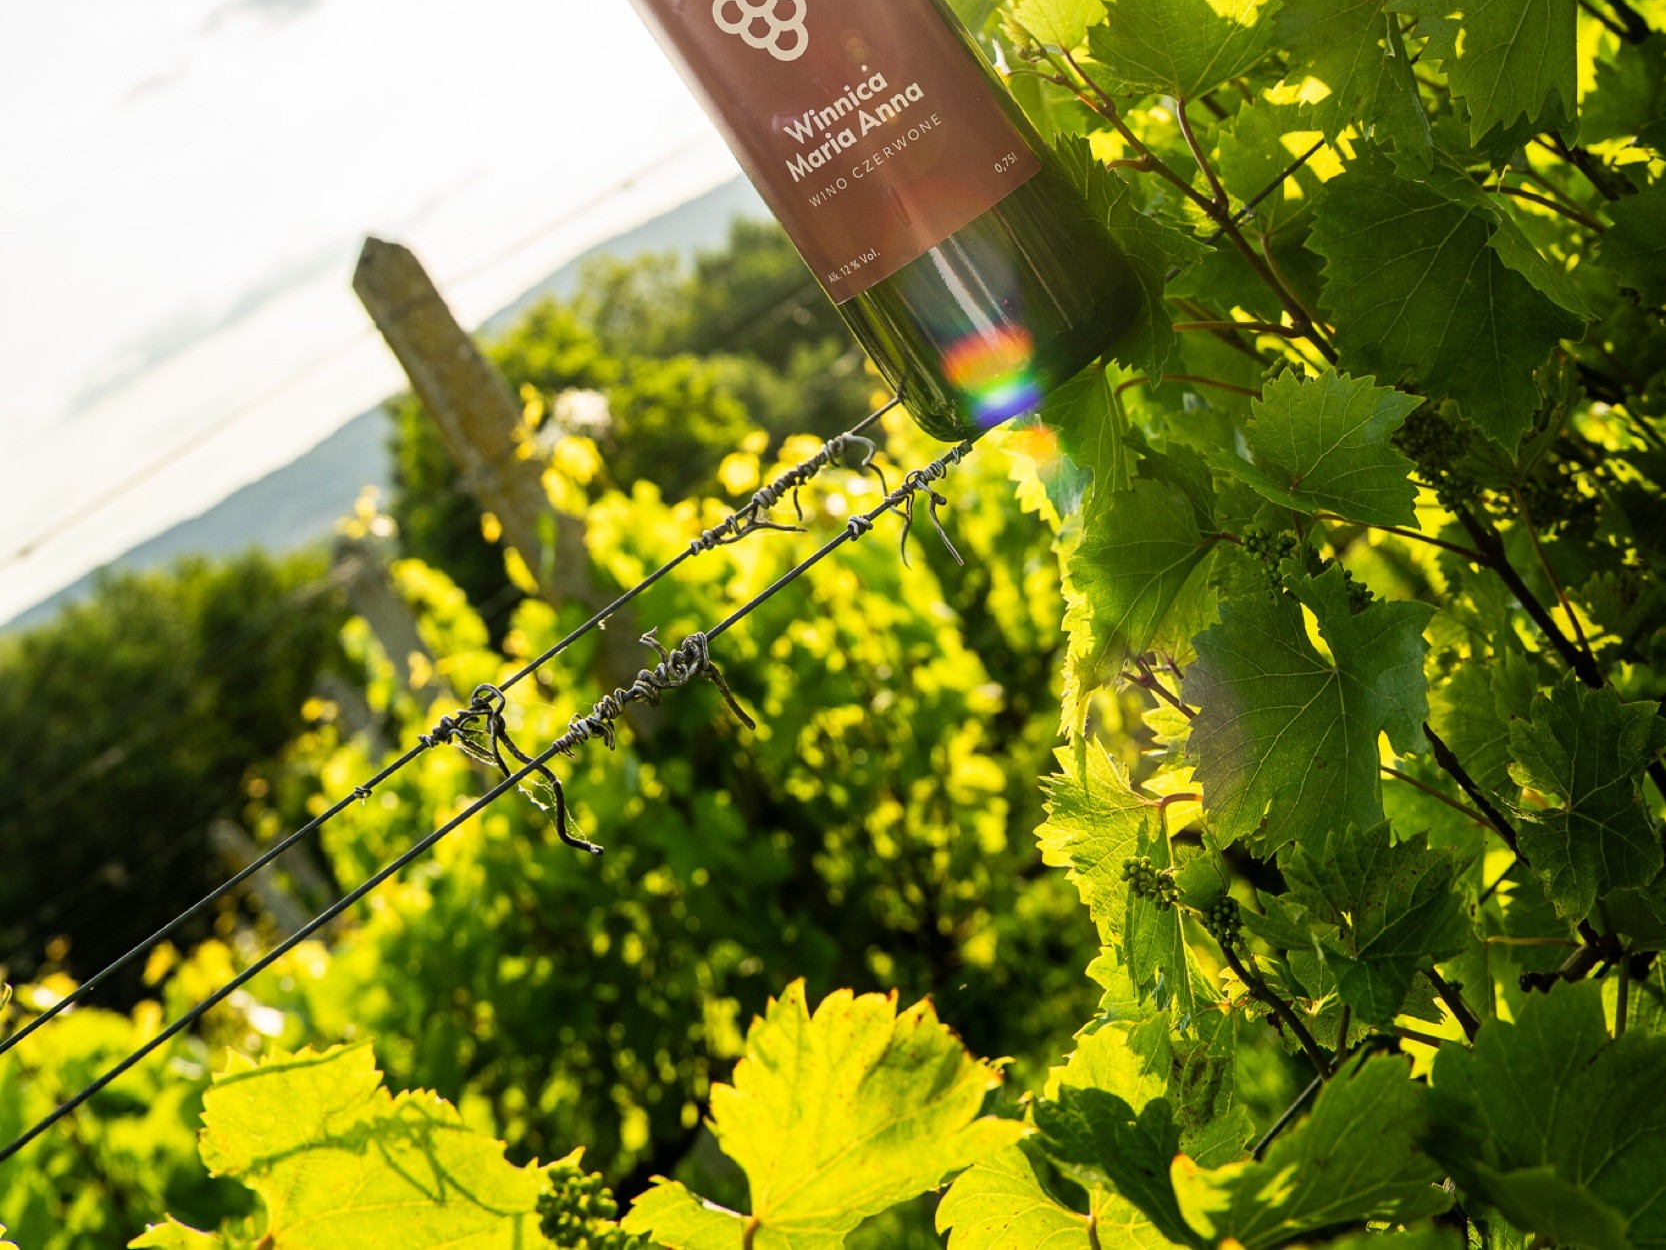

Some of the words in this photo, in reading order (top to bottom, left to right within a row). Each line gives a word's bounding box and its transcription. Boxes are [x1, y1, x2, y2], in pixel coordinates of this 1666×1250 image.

[783, 72, 888, 144] Winnica
[785, 127, 857, 183] Maria
[858, 82, 925, 137] Anna
[808, 177, 848, 207] WINO
[852, 113, 942, 179] CZERWONE
[859, 248, 881, 264] Vol.
